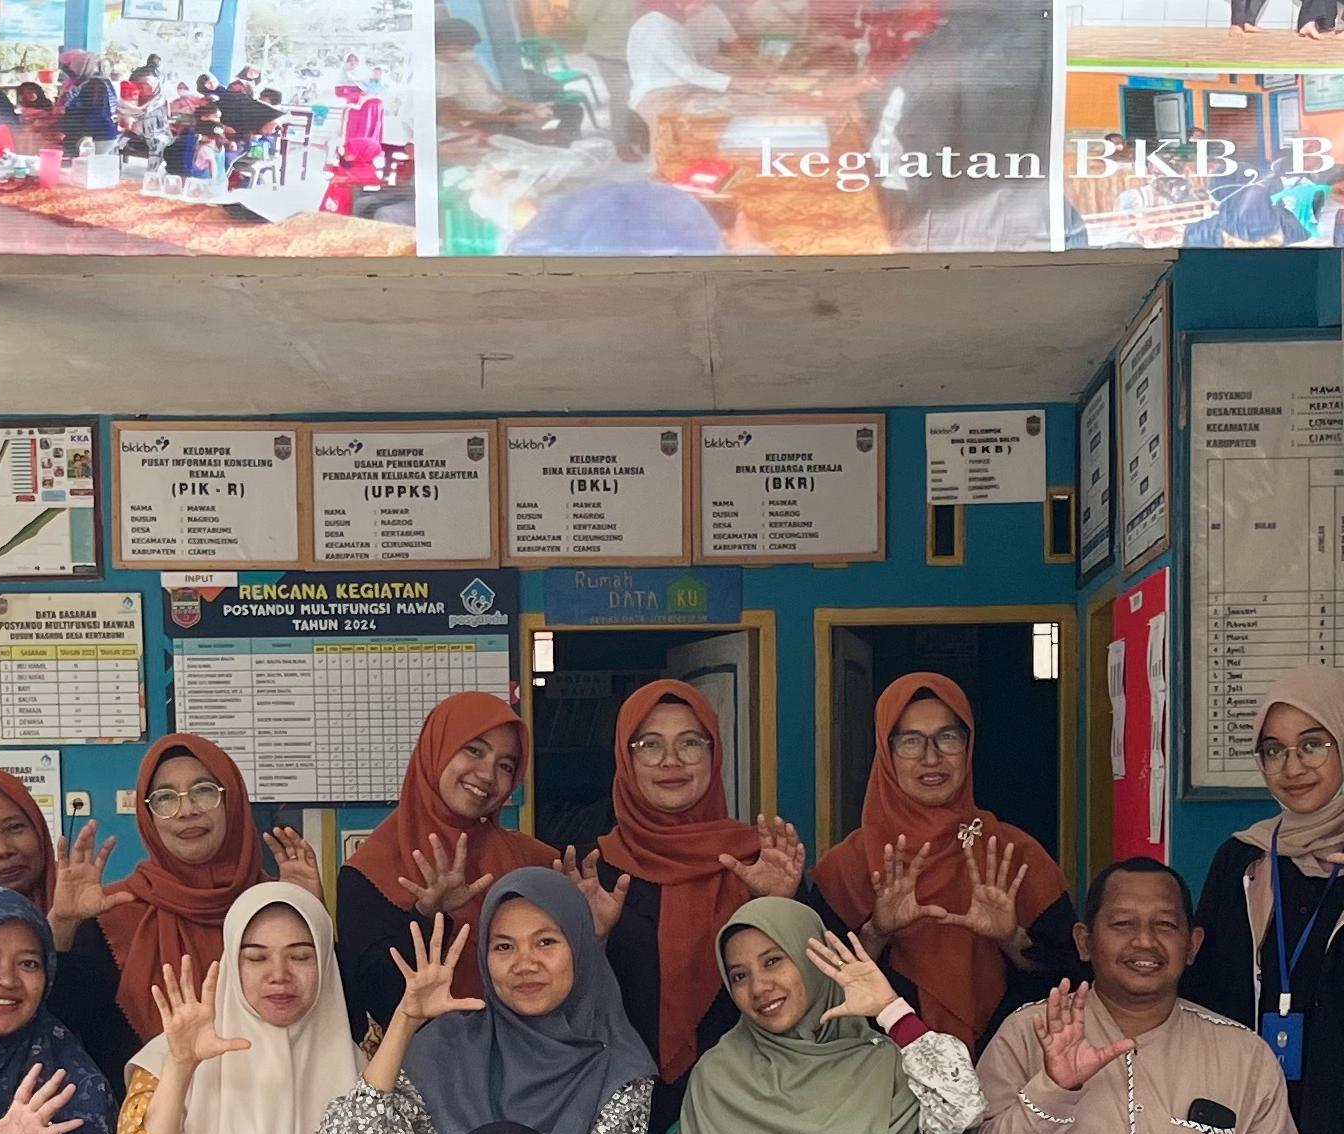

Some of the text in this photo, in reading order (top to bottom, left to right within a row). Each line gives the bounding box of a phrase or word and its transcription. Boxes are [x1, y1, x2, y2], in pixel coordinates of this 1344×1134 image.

[756, 138, 1046, 192] kegiatan
[1070, 139, 1259, 184] BKB,
[1207, 392, 1252, 400] POSYANDU
[1207, 407, 1282, 416] DESA/KELURAHAN
[1207, 423, 1259, 432] KECAMATAN
[122, 442, 158, 453] bkkbn
[509, 440, 544, 450] bkkbn
[1207, 439, 1256, 448] KABUPATEN
[315, 446, 351, 456] bkkbn
[141, 459, 272, 467] PUSAT INFORMASI KONSELING
[354, 460, 446, 468] USAHA PENINGKATAN
[566, 467, 610, 475] KELUARGA
[614, 467, 644, 475] LANSIA
[736, 465, 756, 473] BINA
[759, 465, 804, 473] KELUARGA
[323, 471, 478, 480] PENDAPATAN KELUARGA SEJAHTERA
[570, 479, 618, 494] (BKL)
[765, 477, 814, 492] (BKR)
[172, 483, 209, 498] (PIK
[228, 483, 245, 498] R)
[365, 485, 438, 500] (UPPKS)
[184, 574, 214, 583] INPUT
[575, 571, 633, 589] Rumah
[239, 583, 429, 601] RENCANA KEGIATAN
[609, 590, 697, 609] DATA KU
[223, 602, 445, 616] POSYANDU MULTIFUNGSI MAWAR
[36, 611, 56, 619] DATA
[0, 621, 135, 630] POSYANDU MULTIFUNGSI MAWAR
[292, 619, 377, 632] TAHUN 2024
